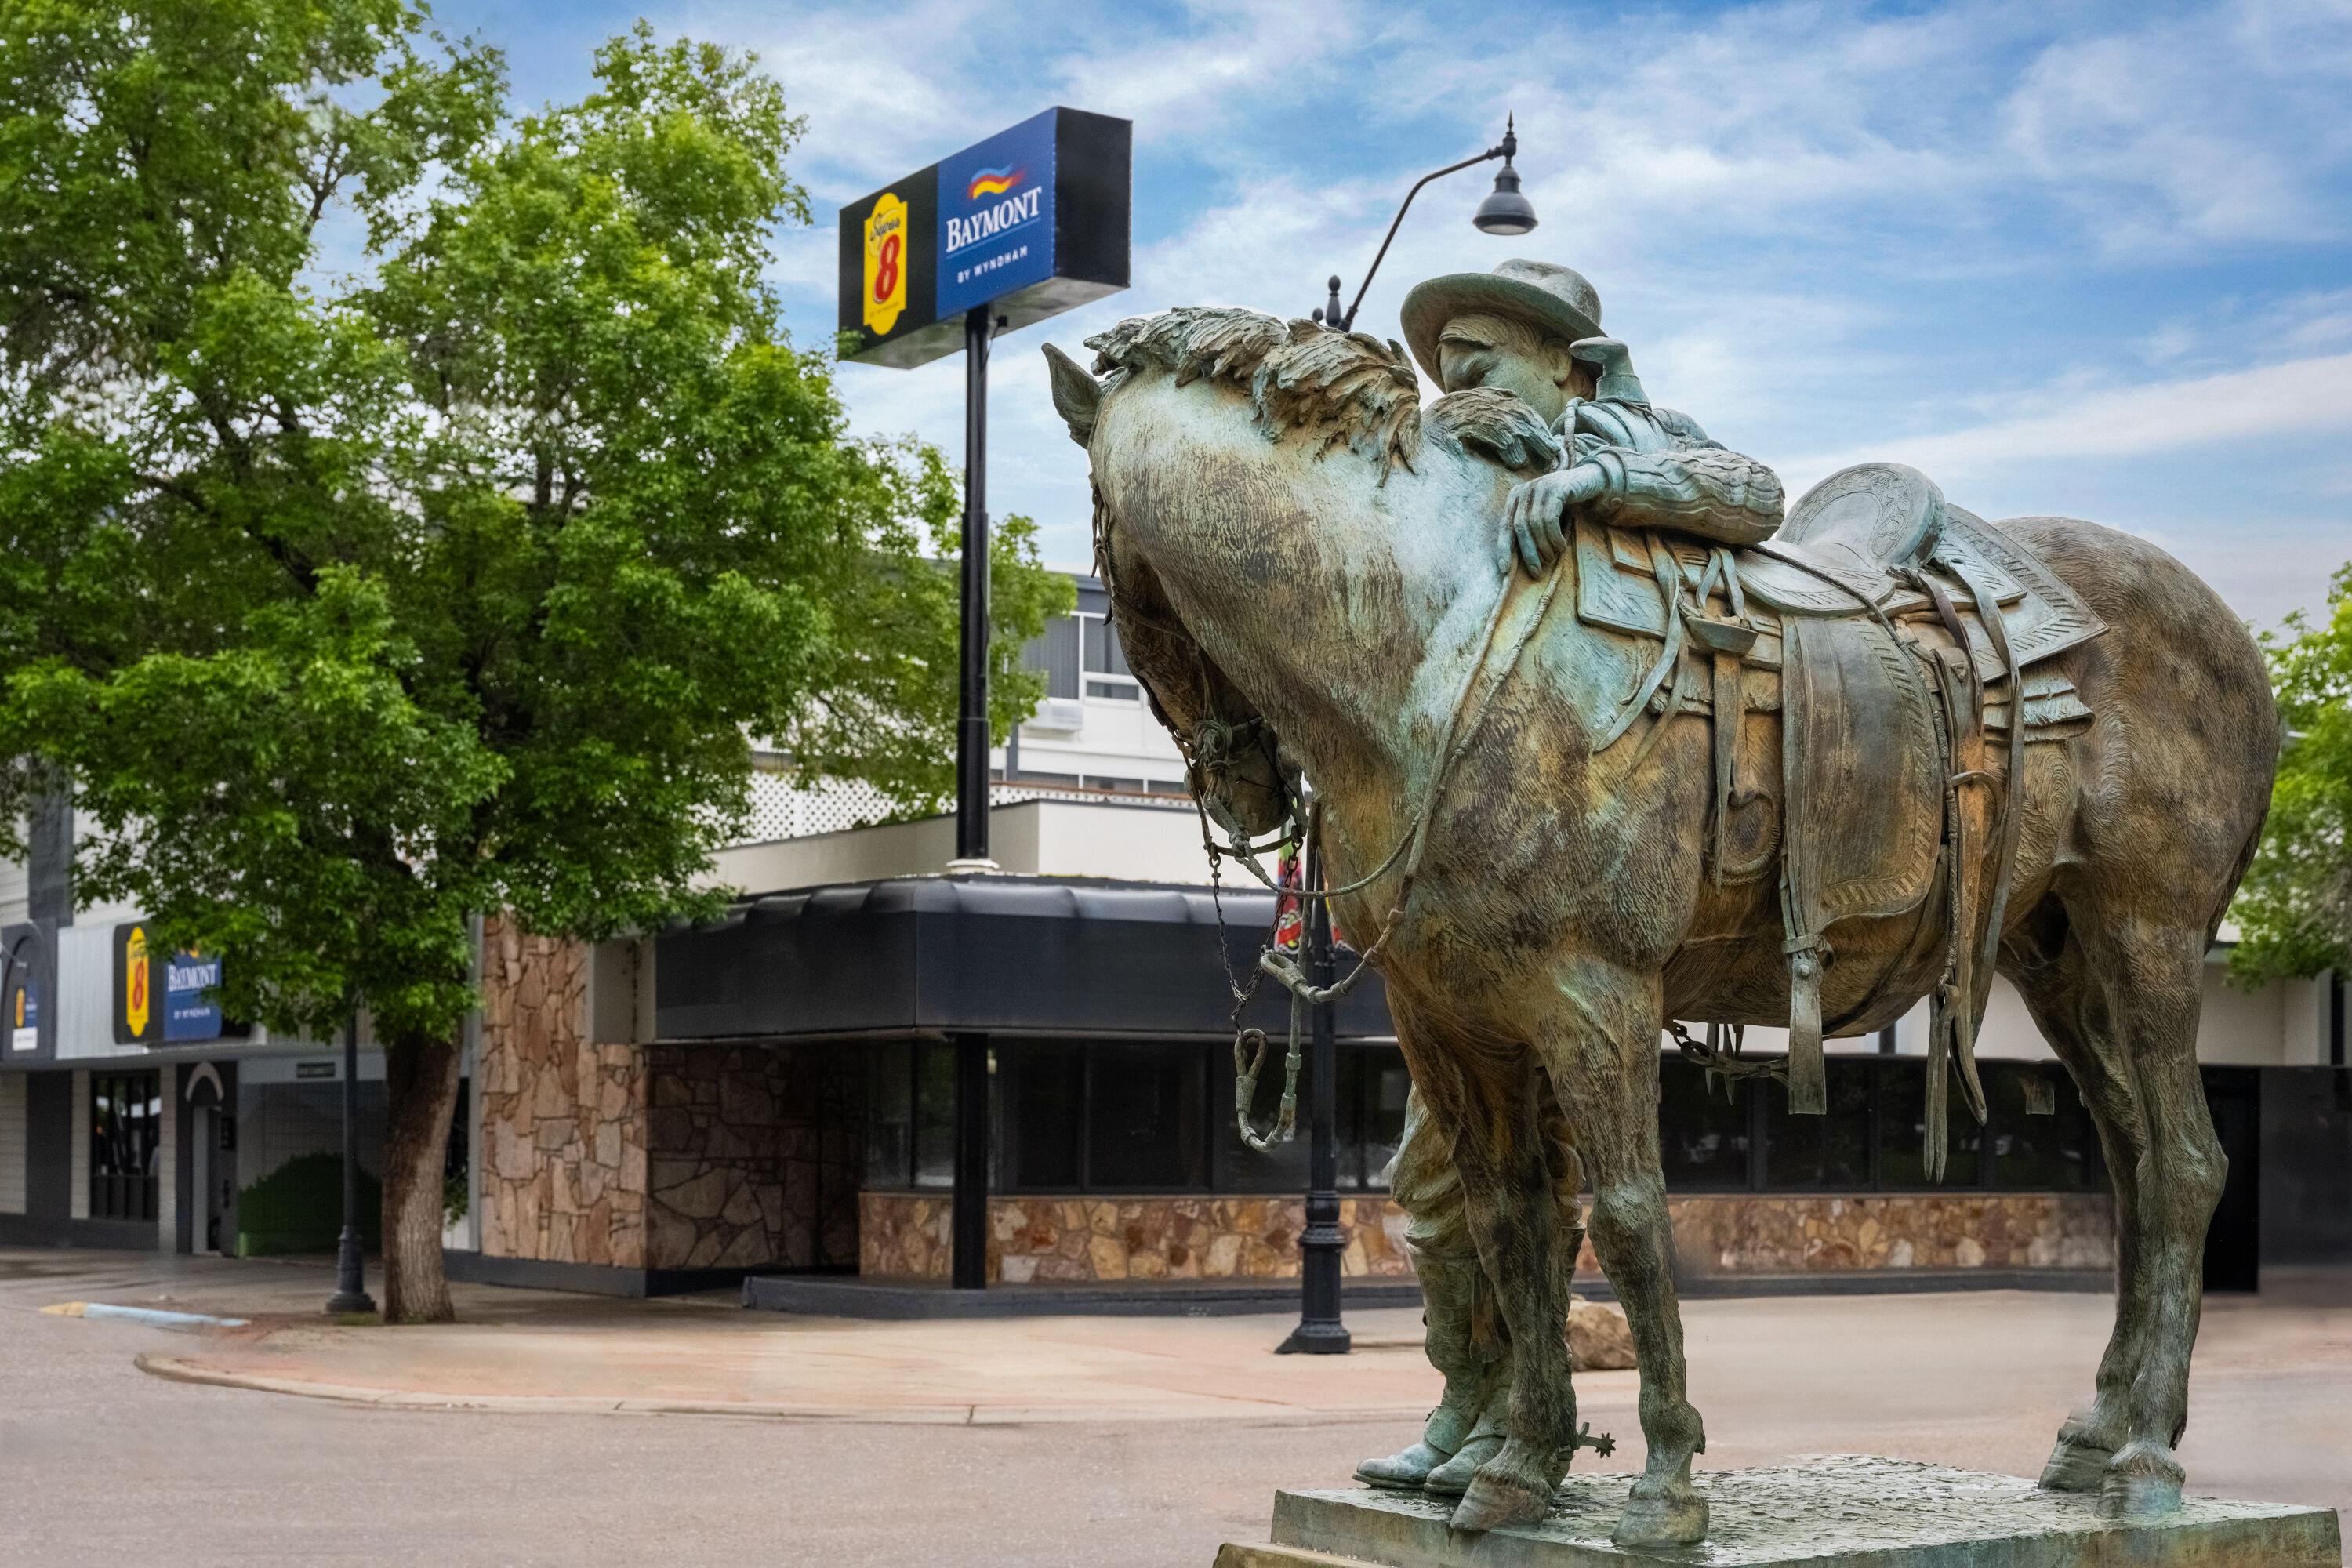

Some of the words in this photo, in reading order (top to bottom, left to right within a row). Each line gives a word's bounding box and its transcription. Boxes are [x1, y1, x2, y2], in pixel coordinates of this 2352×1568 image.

[946, 186, 1042, 252] BAYMONT
[873, 234, 900, 304] 8
[957, 269, 971, 283] BY
[974, 245, 1028, 276] WYNDHAM
[132, 960, 144, 1011] 8
